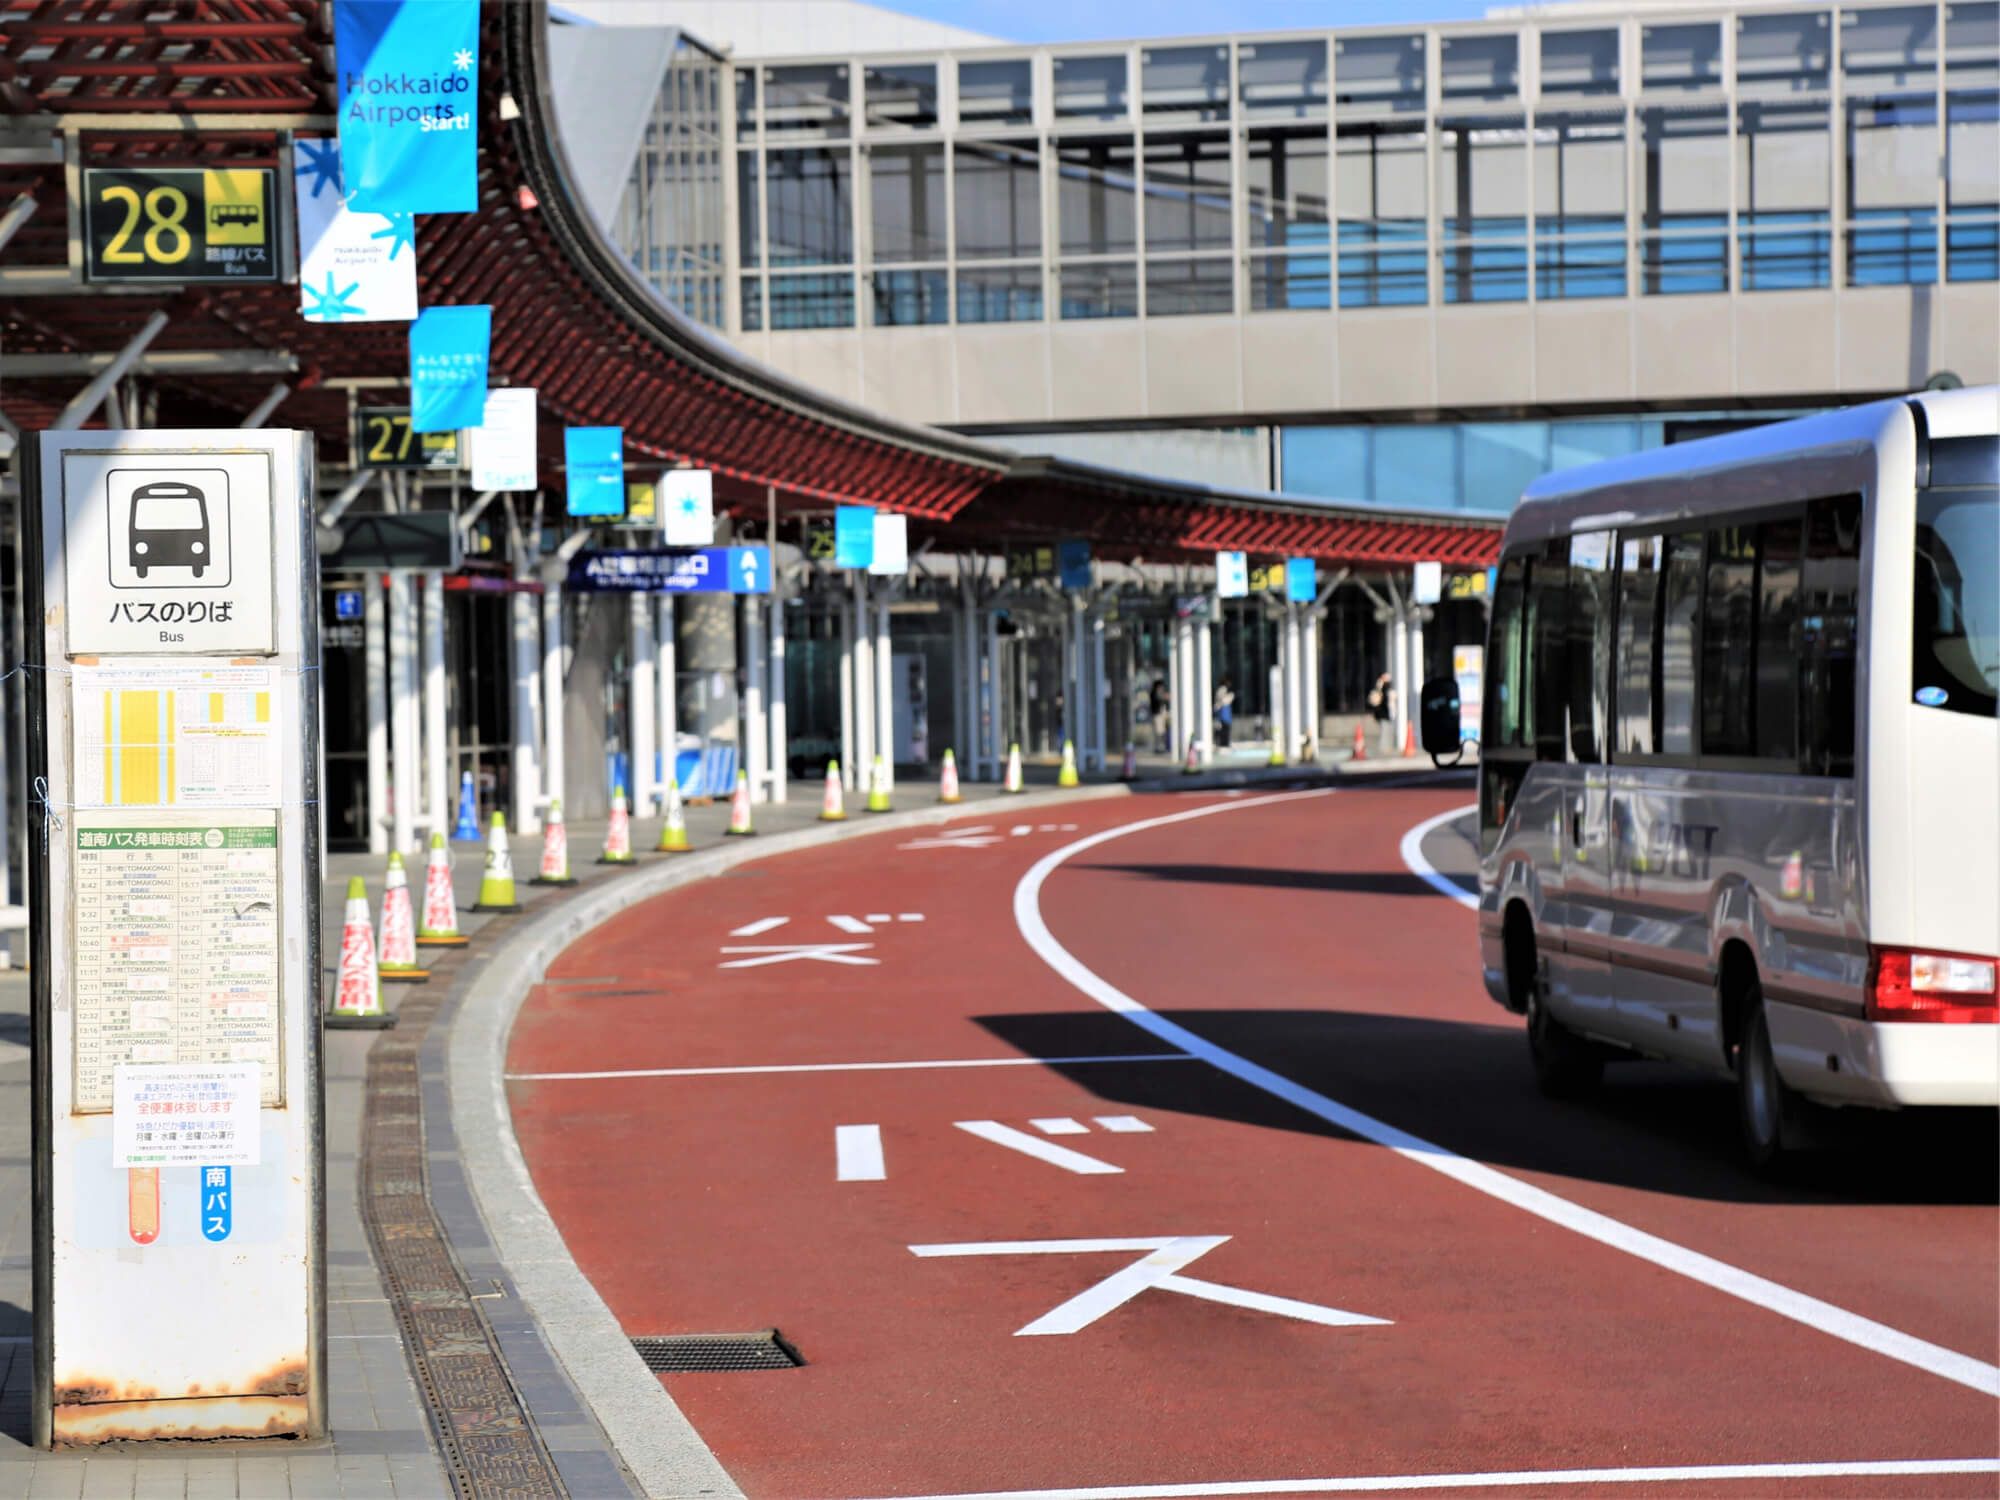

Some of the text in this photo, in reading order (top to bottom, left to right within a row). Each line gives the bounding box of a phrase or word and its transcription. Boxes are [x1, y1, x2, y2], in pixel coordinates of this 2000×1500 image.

[346, 72, 469, 94] Hokkaido
[349, 100, 455, 127] Airports
[419, 112, 469, 132] Start!
[101, 186, 192, 264] 28
[368, 416, 414, 461] 27
[110, 601, 233, 623] バスのりば
[159, 631, 185, 642] Bus
[79, 832, 203, 847] 道南バス発車時刻表
[484, 849, 513, 871] 27
[138, 1101, 233, 1115] 全便運休致します
[206, 1167, 228, 1234] 南バス
[835, 1115, 1396, 1337] バス
